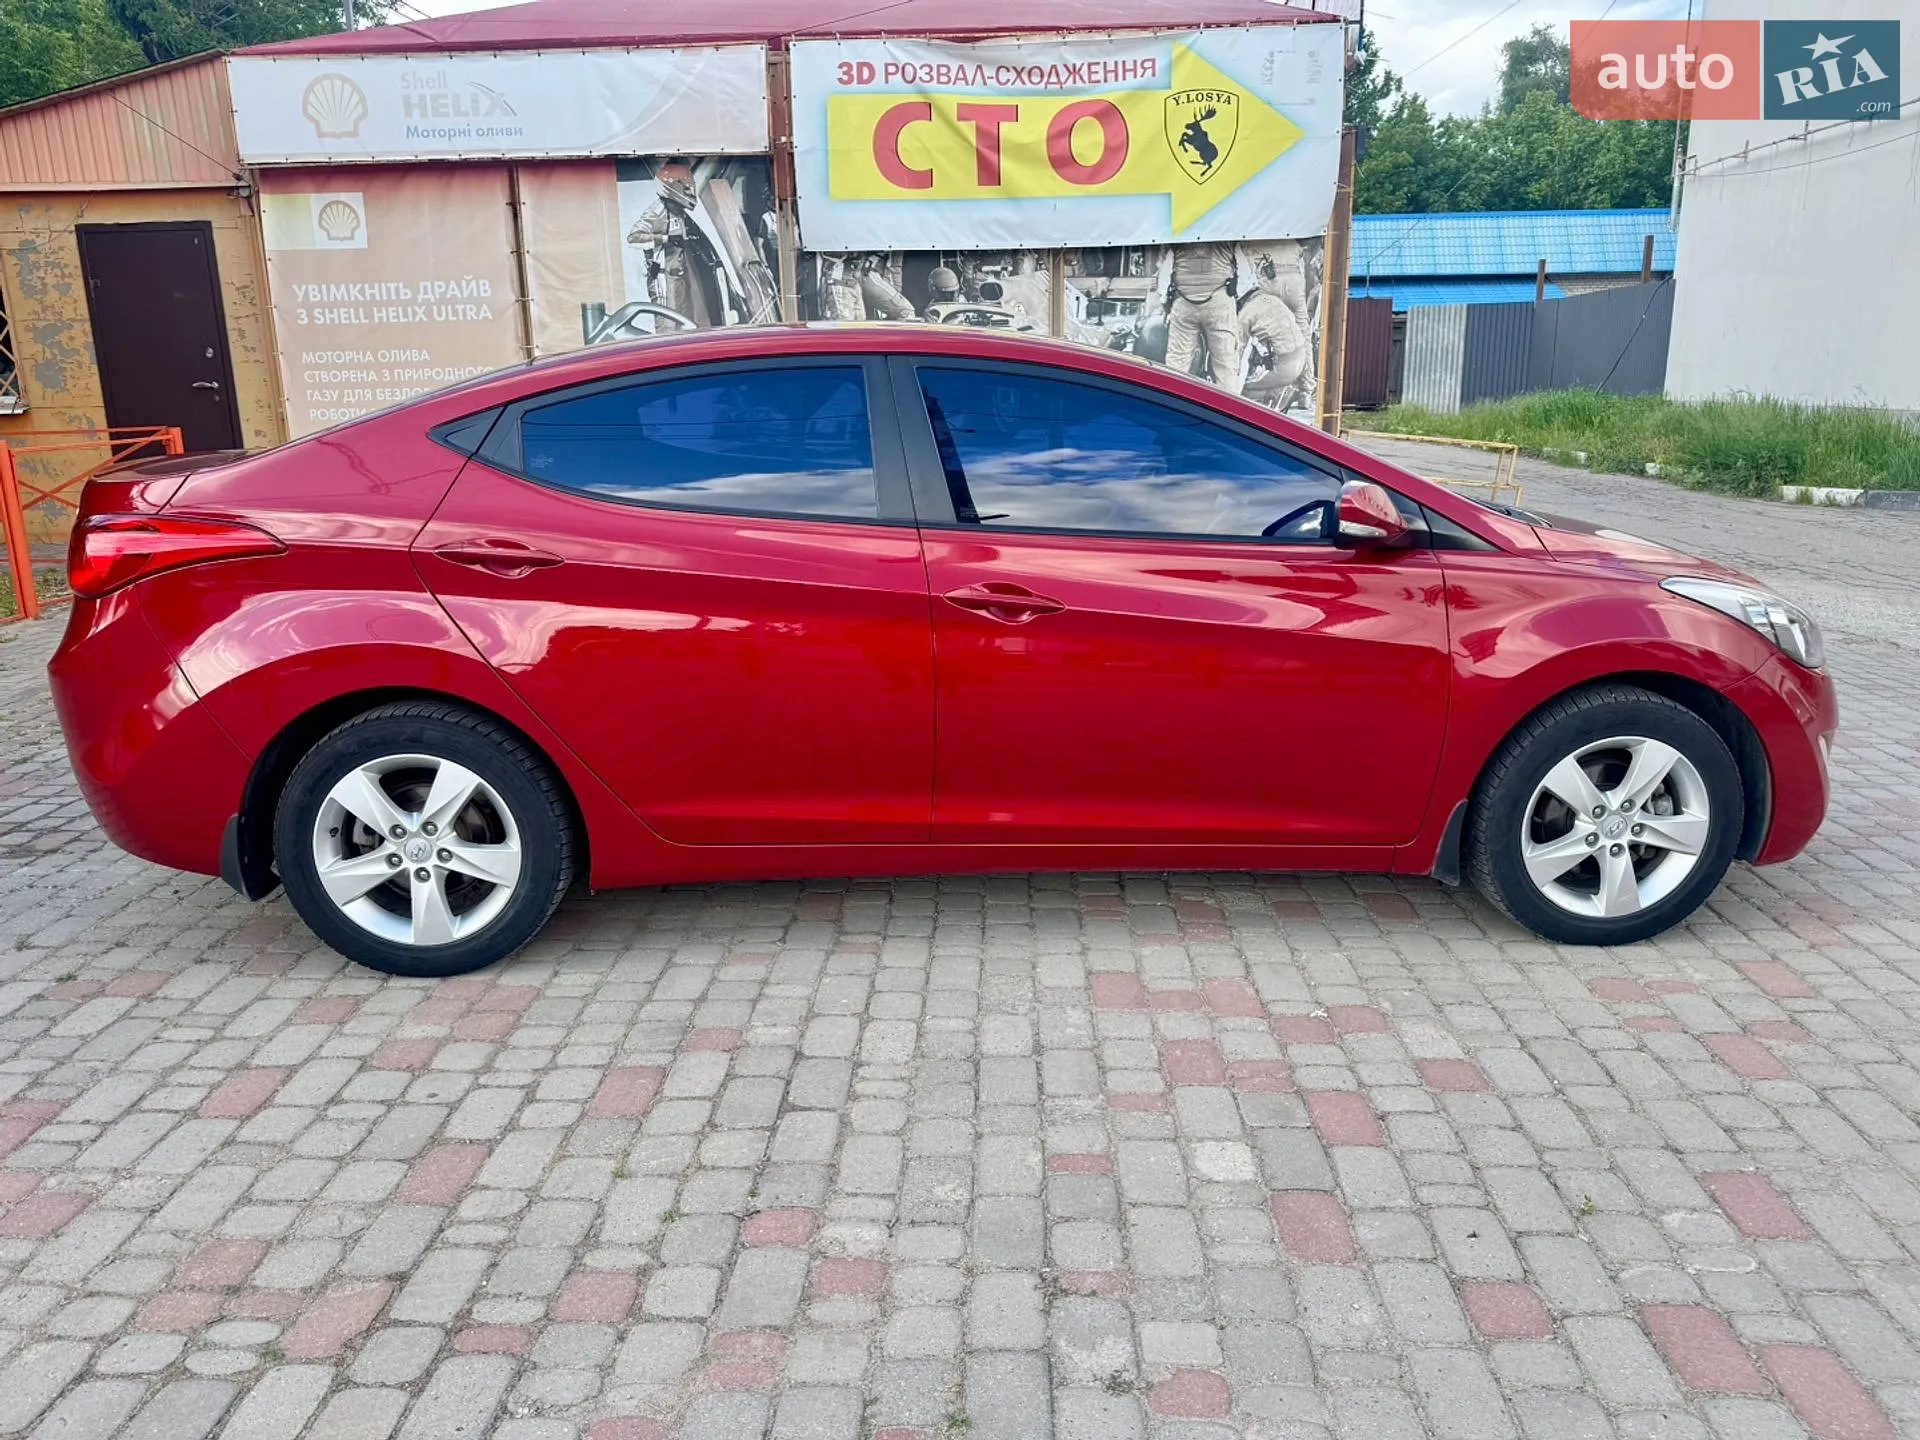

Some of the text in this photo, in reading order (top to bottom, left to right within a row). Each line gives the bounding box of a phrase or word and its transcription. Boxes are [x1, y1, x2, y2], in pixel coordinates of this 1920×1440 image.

[401, 70, 448, 90] Shell
[836, 58, 1157, 89] 3D РОЗВАЛ-СХОДЖЕННЯ
[401, 87, 515, 119] HELIX
[1172, 92, 1232, 107] Y.LOSYA
[406, 123, 524, 141] Моторні оливи
[872, 99, 1130, 190] СТО
[292, 275, 492, 302] УВІМКНІТЬ ДРАЙВ
[314, 307, 369, 324] SHELL
[373, 306, 427, 323] HELIX
[433, 304, 493, 321] ULTRA
[302, 350, 430, 364] МОТОРНА ОЛИВА
[304, 369, 378, 383] СТВОРЕНА
[307, 389, 339, 402] ГАЗУ
[344, 389, 373, 404] ДЛЯ
